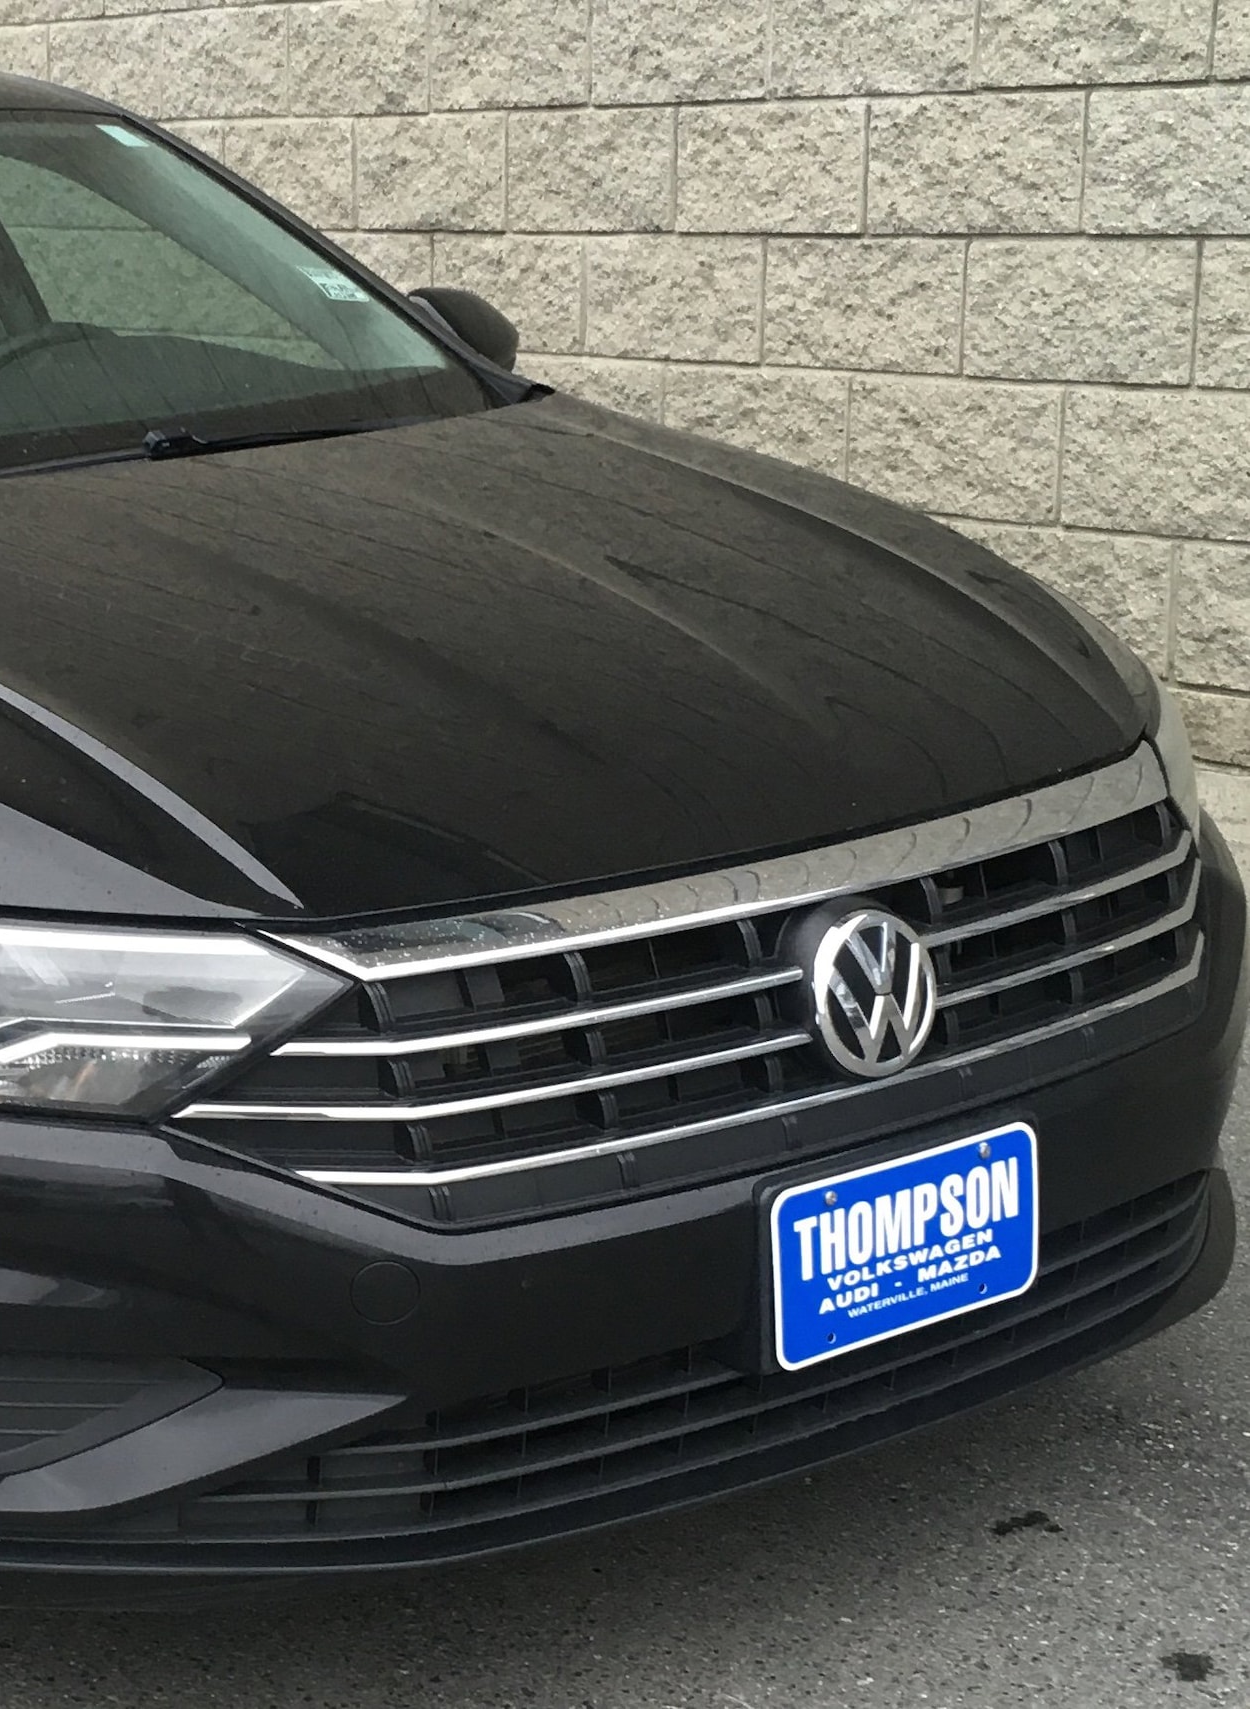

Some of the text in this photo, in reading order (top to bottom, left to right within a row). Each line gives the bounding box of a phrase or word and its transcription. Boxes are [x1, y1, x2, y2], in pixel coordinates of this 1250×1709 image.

[793, 1156, 1019, 1282] THOMPSON
[818, 1283, 879, 1315] AUDI
[917, 1245, 1002, 1283] MAZDA
[827, 1228, 993, 1291] VOLKSWAGEN
[848, 1273, 969, 1318] WATERVILLE, MAINE
